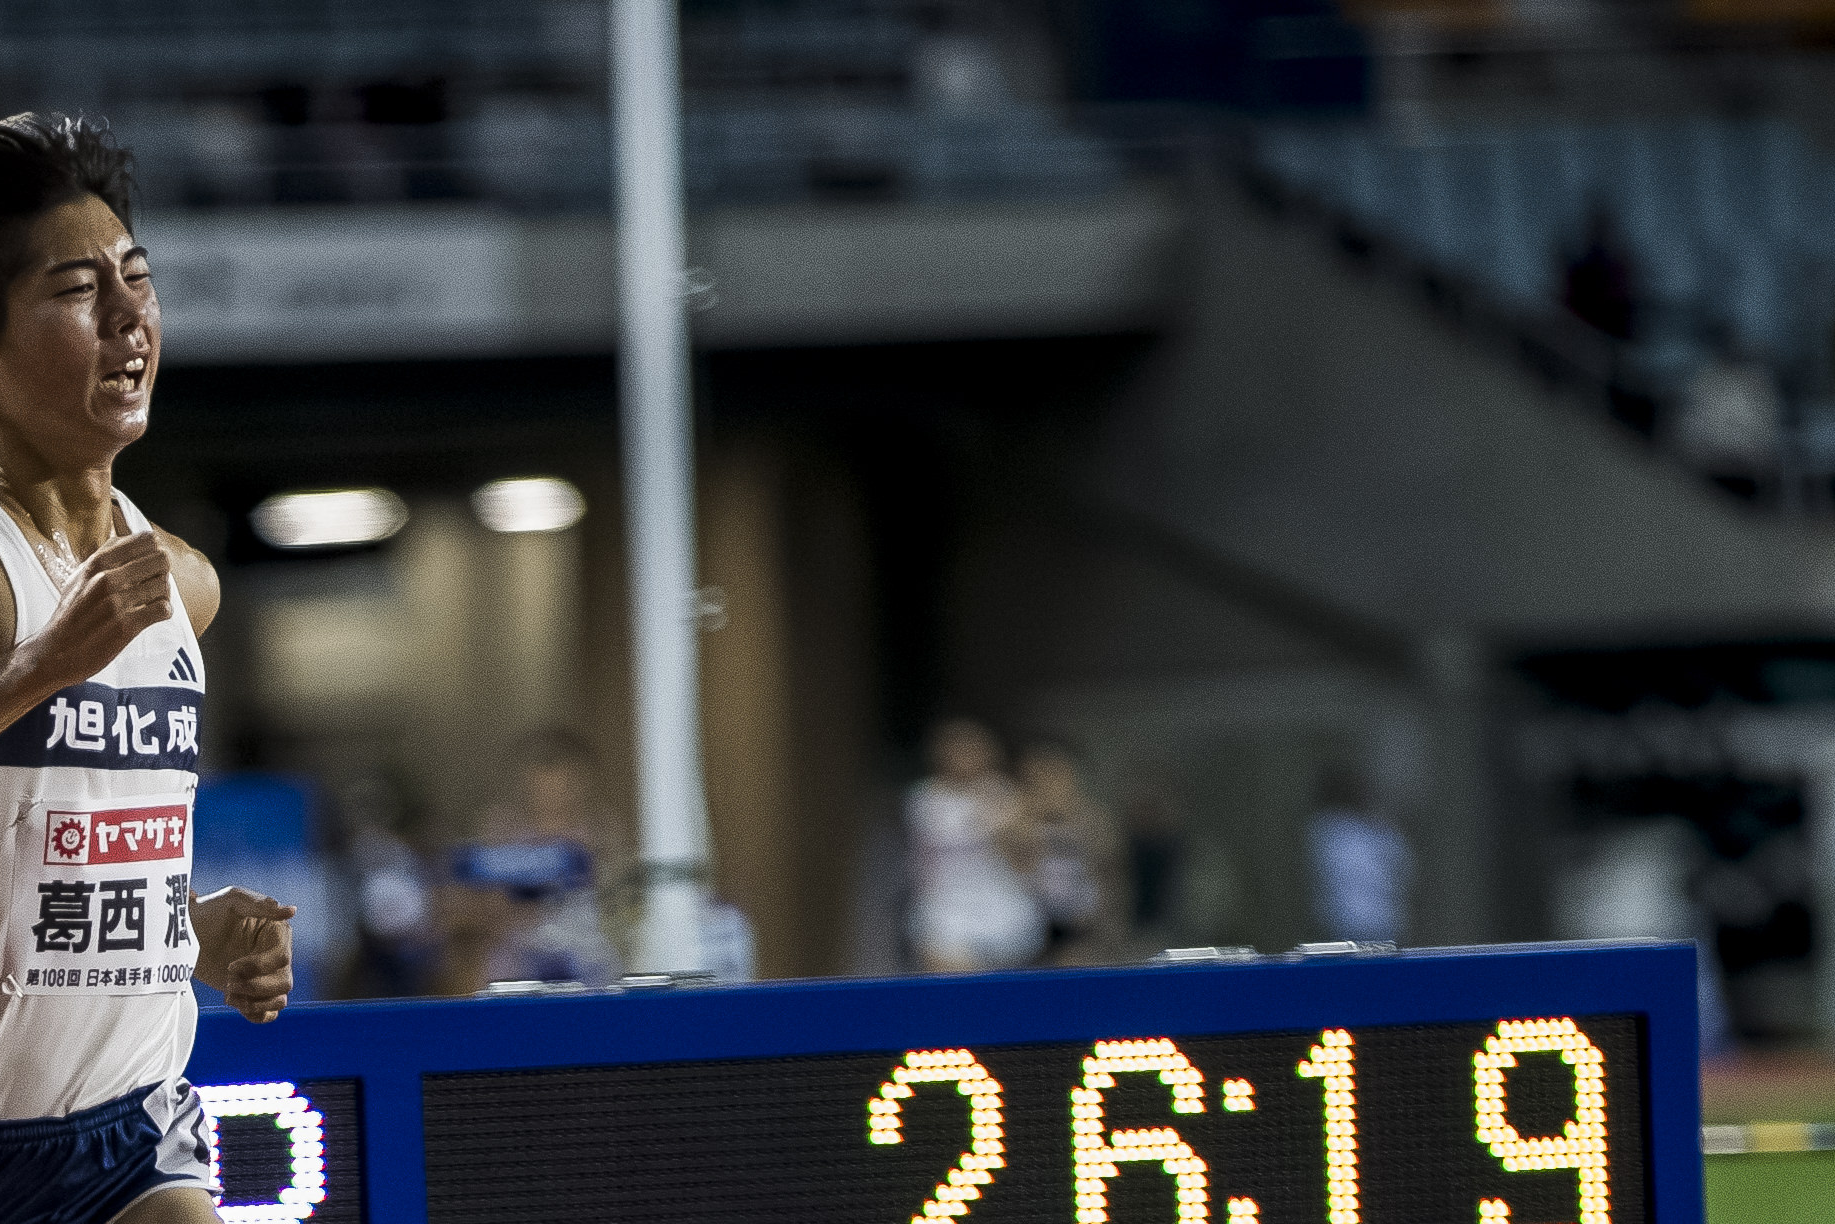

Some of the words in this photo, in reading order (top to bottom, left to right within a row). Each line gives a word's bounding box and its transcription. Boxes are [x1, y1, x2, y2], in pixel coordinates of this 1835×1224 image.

[46, 697, 198, 756] 旭化成
[95, 816, 184, 854] ヤマザキ
[31, 878, 148, 954] 葛西
